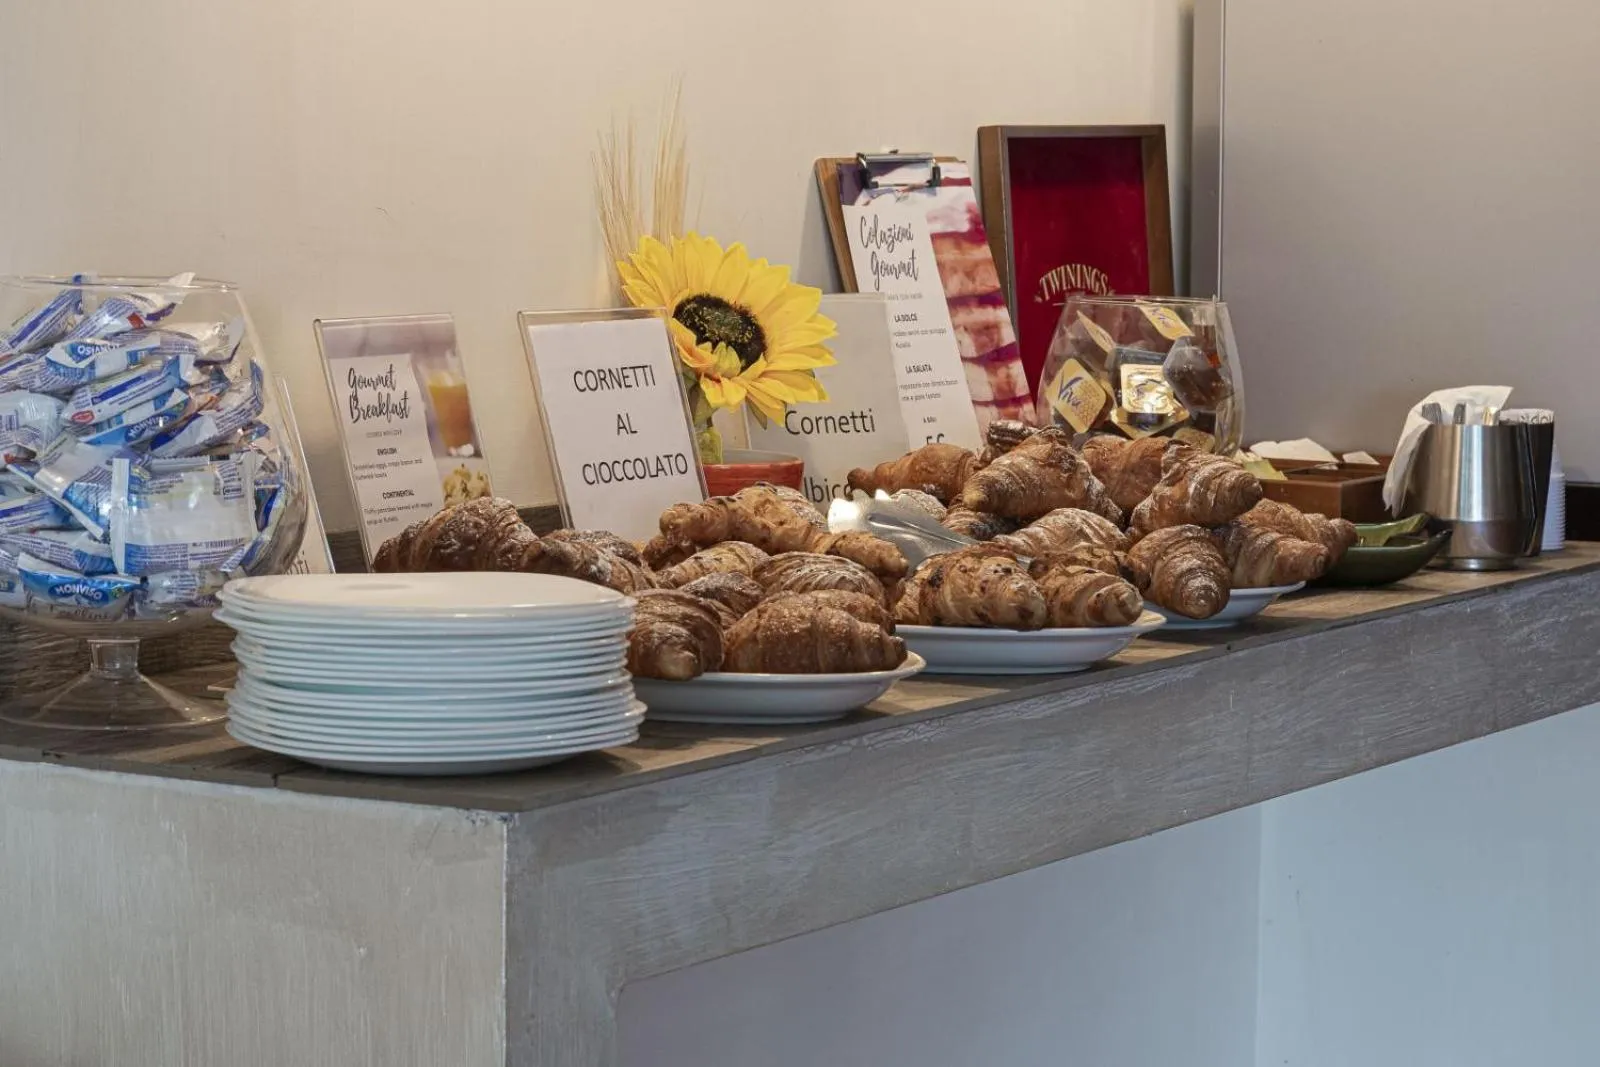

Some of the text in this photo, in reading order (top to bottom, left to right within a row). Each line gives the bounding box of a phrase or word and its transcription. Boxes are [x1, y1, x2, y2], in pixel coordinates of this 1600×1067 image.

[1039, 263, 1109, 301] TWININGS
[347, 364, 397, 399] Gourmet
[573, 364, 656, 392] CORNETTI
[349, 390, 410, 424] Breakfast
[784, 408, 876, 435] Cornetti
[616, 412, 638, 436] AL
[582, 452, 688, 486] CIOCCOLATO
[55, 583, 103, 600] MONVISO
